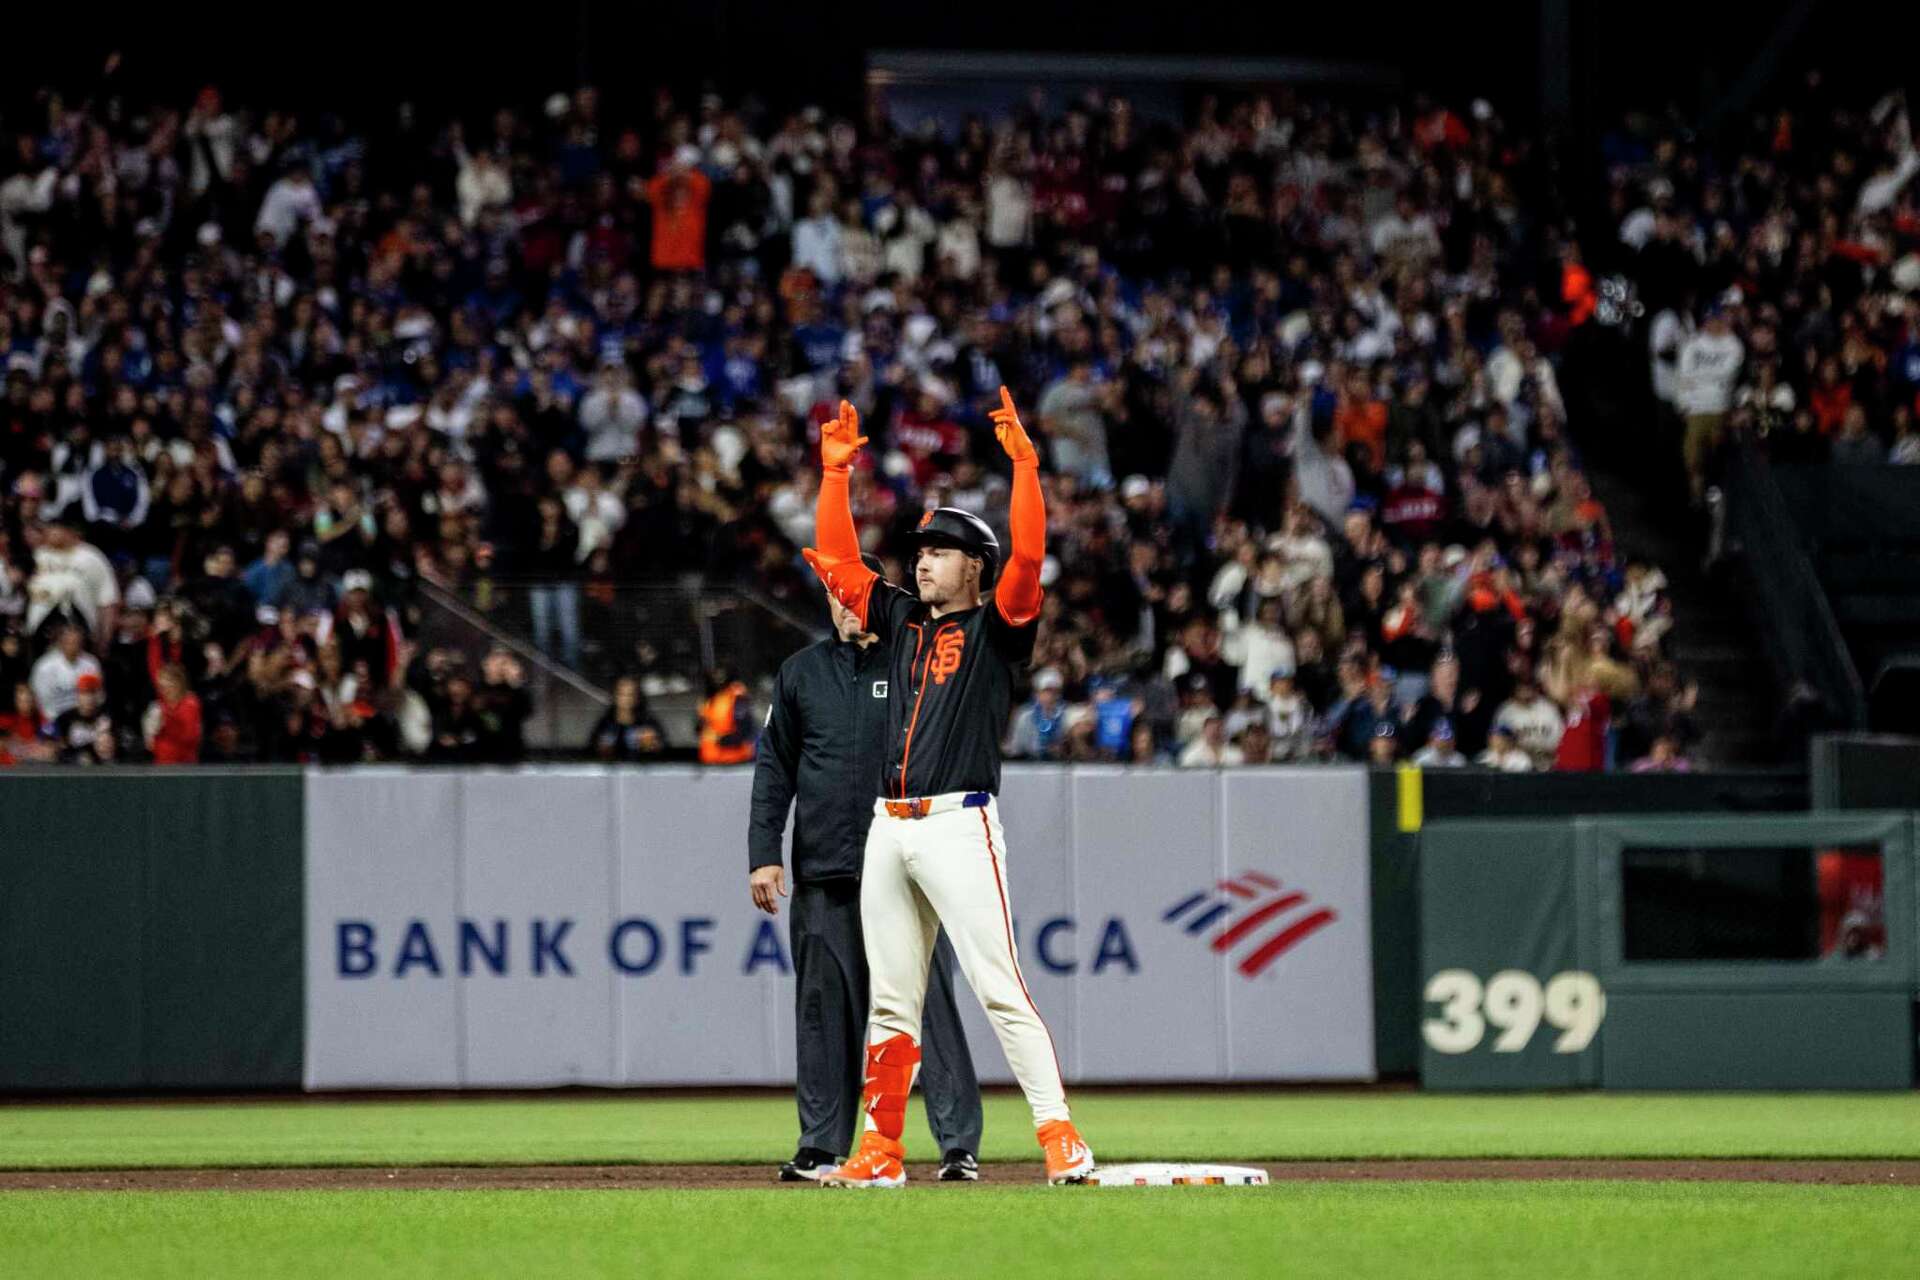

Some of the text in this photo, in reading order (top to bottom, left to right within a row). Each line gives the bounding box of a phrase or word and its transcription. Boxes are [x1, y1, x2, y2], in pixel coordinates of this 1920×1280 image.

[335, 918, 576, 978] BANK
[607, 917, 715, 977] OF
[1422, 968, 1606, 1054] 399
